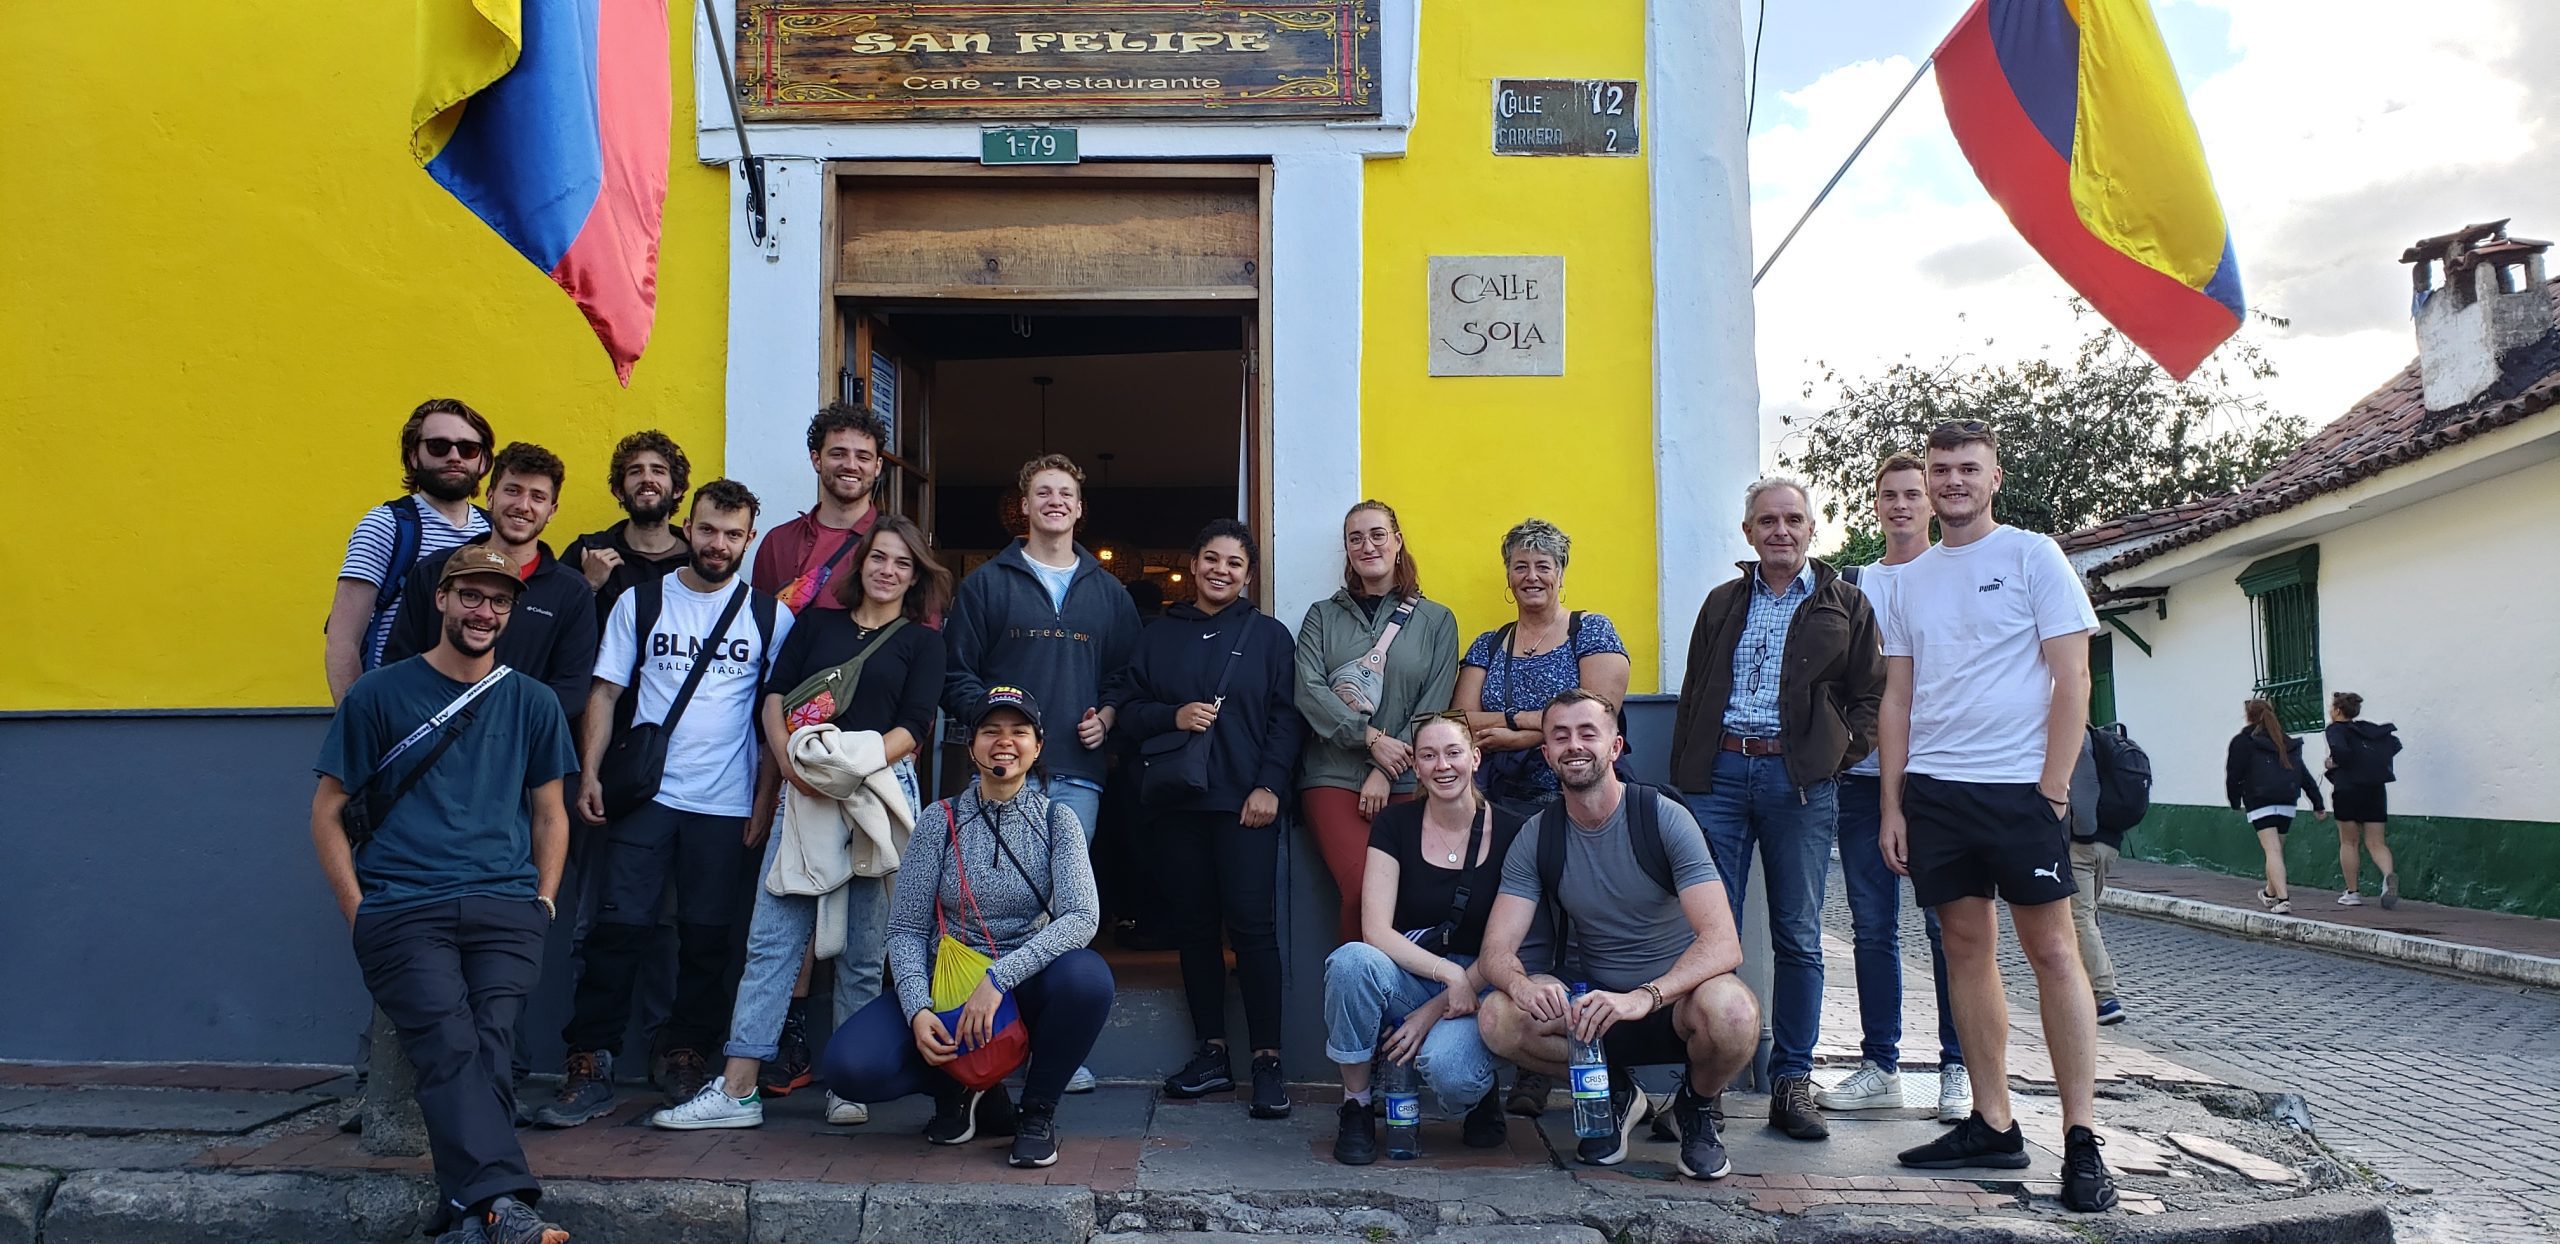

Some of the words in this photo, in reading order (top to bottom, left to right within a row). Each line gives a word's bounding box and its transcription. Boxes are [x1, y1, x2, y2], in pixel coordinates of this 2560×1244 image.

[851, 32, 992, 54] SAN
[1016, 31, 1270, 54] FELIPE
[1017, 75, 1221, 90] Restaurante
[1005, 134, 1057, 157] 1-79
[1499, 128, 1563, 145] CARRERA
[1605, 129, 1617, 152] 2
[1978, 583, 2000, 592] PUMA
[658, 662, 744, 676] BALEIAGA
